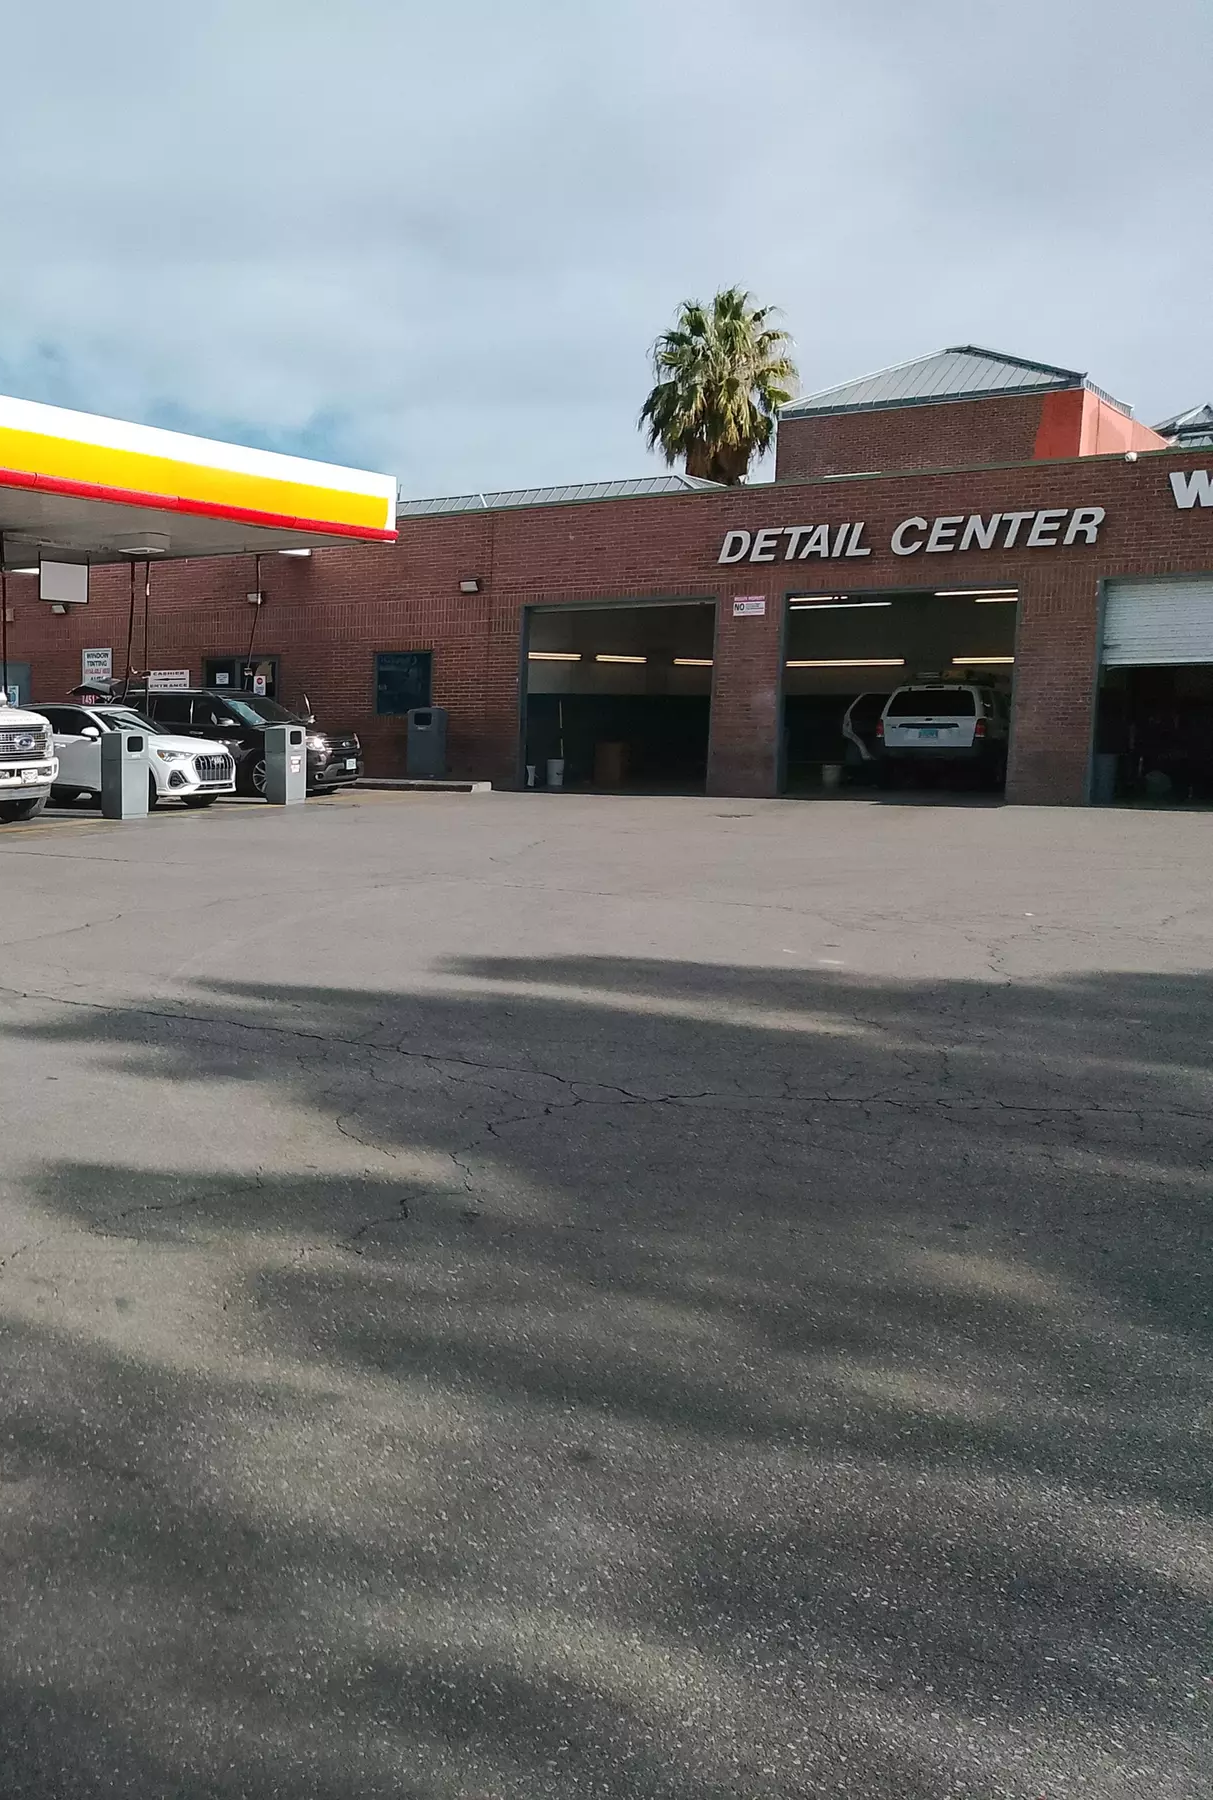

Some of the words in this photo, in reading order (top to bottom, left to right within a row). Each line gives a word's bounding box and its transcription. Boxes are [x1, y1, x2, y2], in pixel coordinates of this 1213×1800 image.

[718, 521, 871, 563] DETAIL
[890, 507, 1106, 556] CENTER
[734, 603, 745, 611] NO
